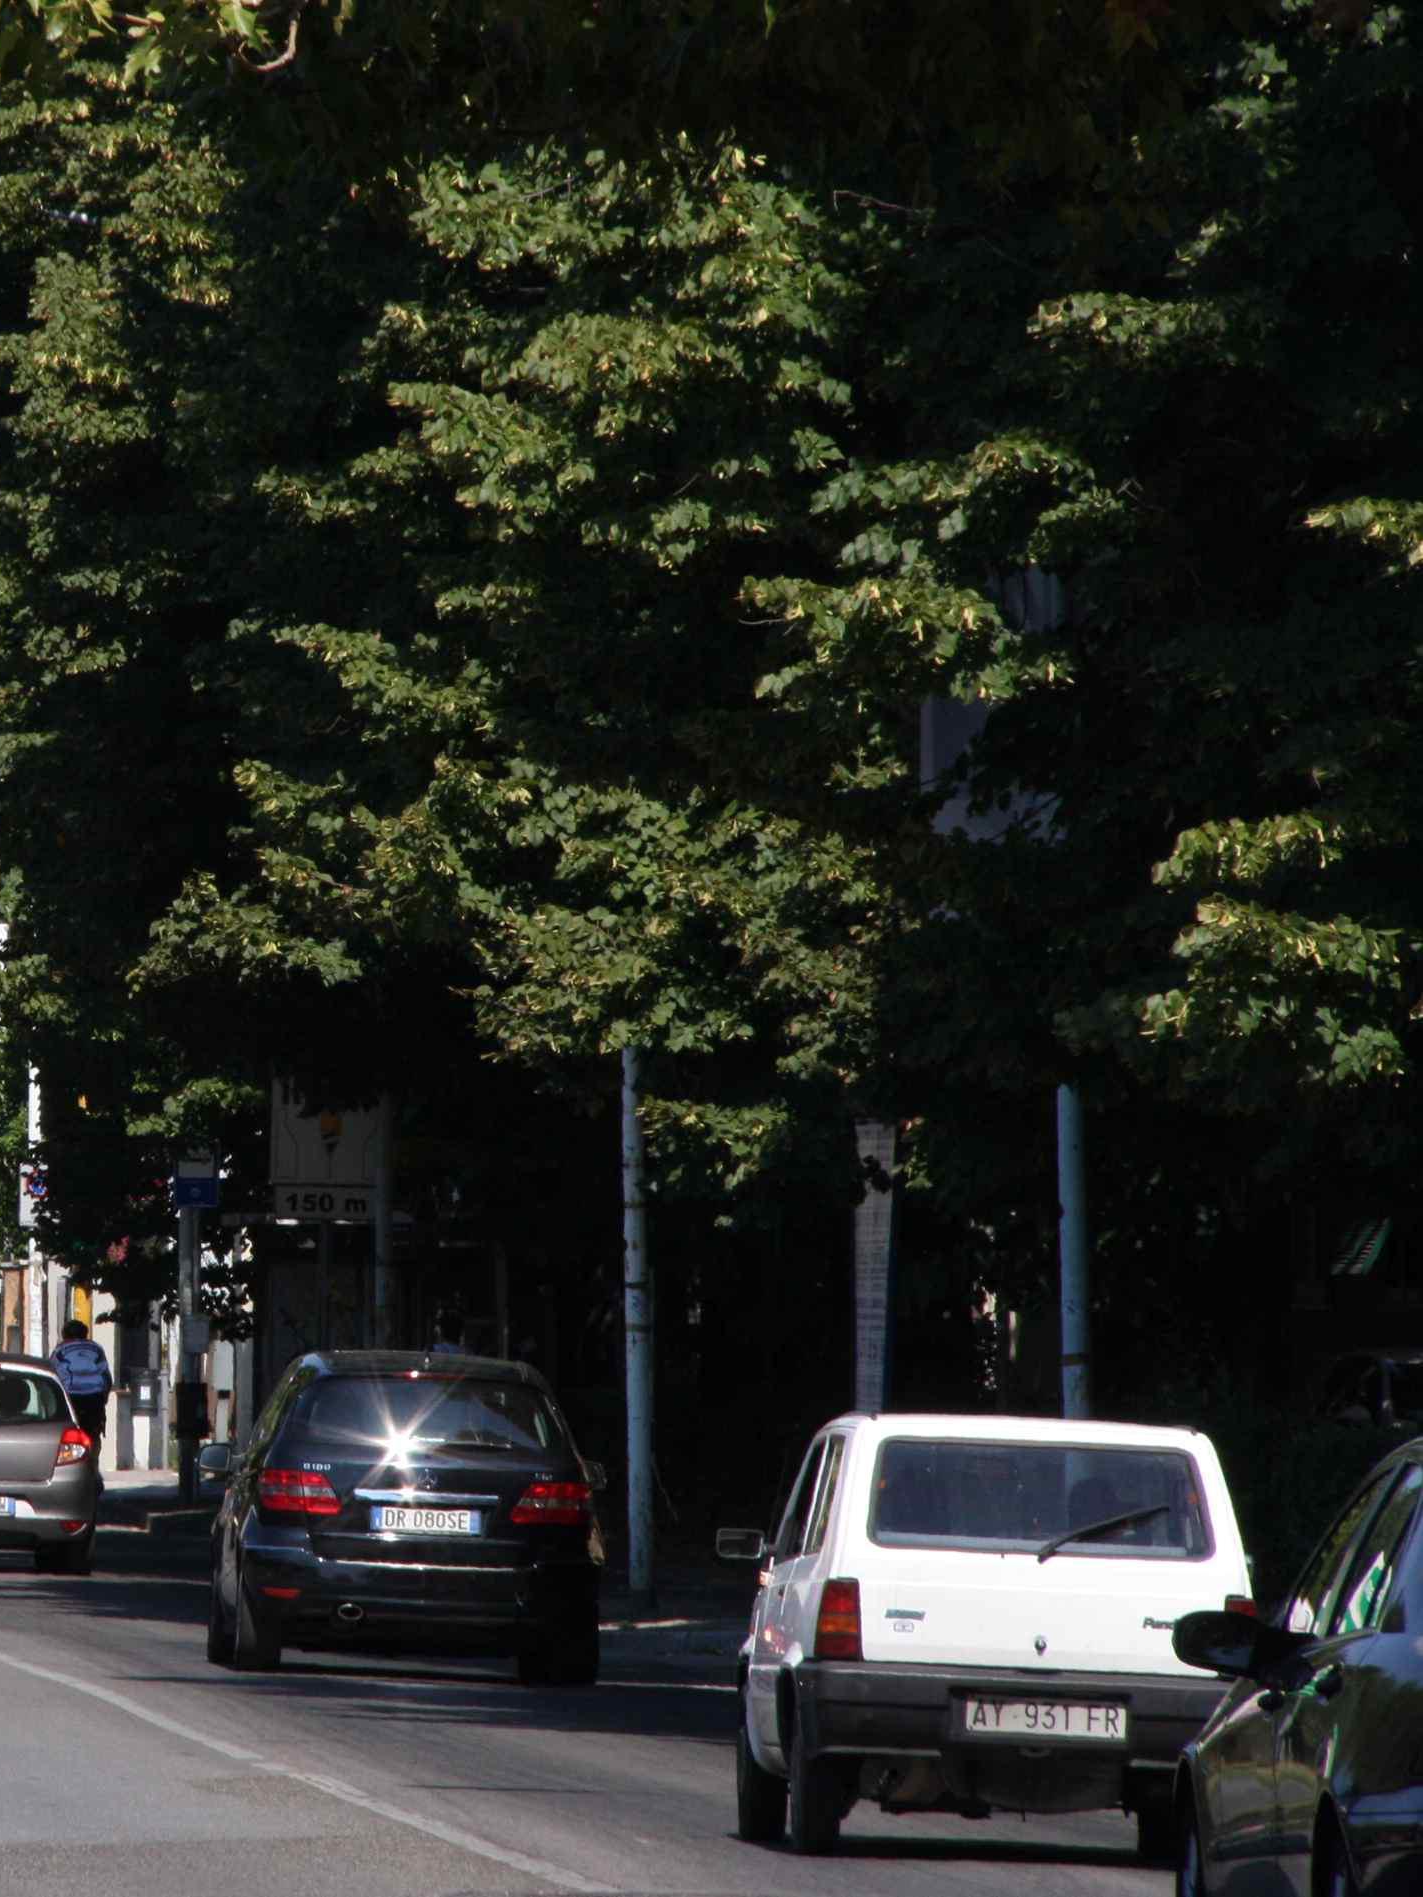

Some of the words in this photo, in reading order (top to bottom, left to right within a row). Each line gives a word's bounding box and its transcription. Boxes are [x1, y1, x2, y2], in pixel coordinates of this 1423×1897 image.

[286, 1194, 334, 1213] 150
[344, 1198, 367, 1213] m
[385, 1509, 406, 1527] DR
[413, 1511, 468, 1530] 080SE
[973, 1703, 1003, 1726] AY
[1086, 1706, 1119, 1733] FR
